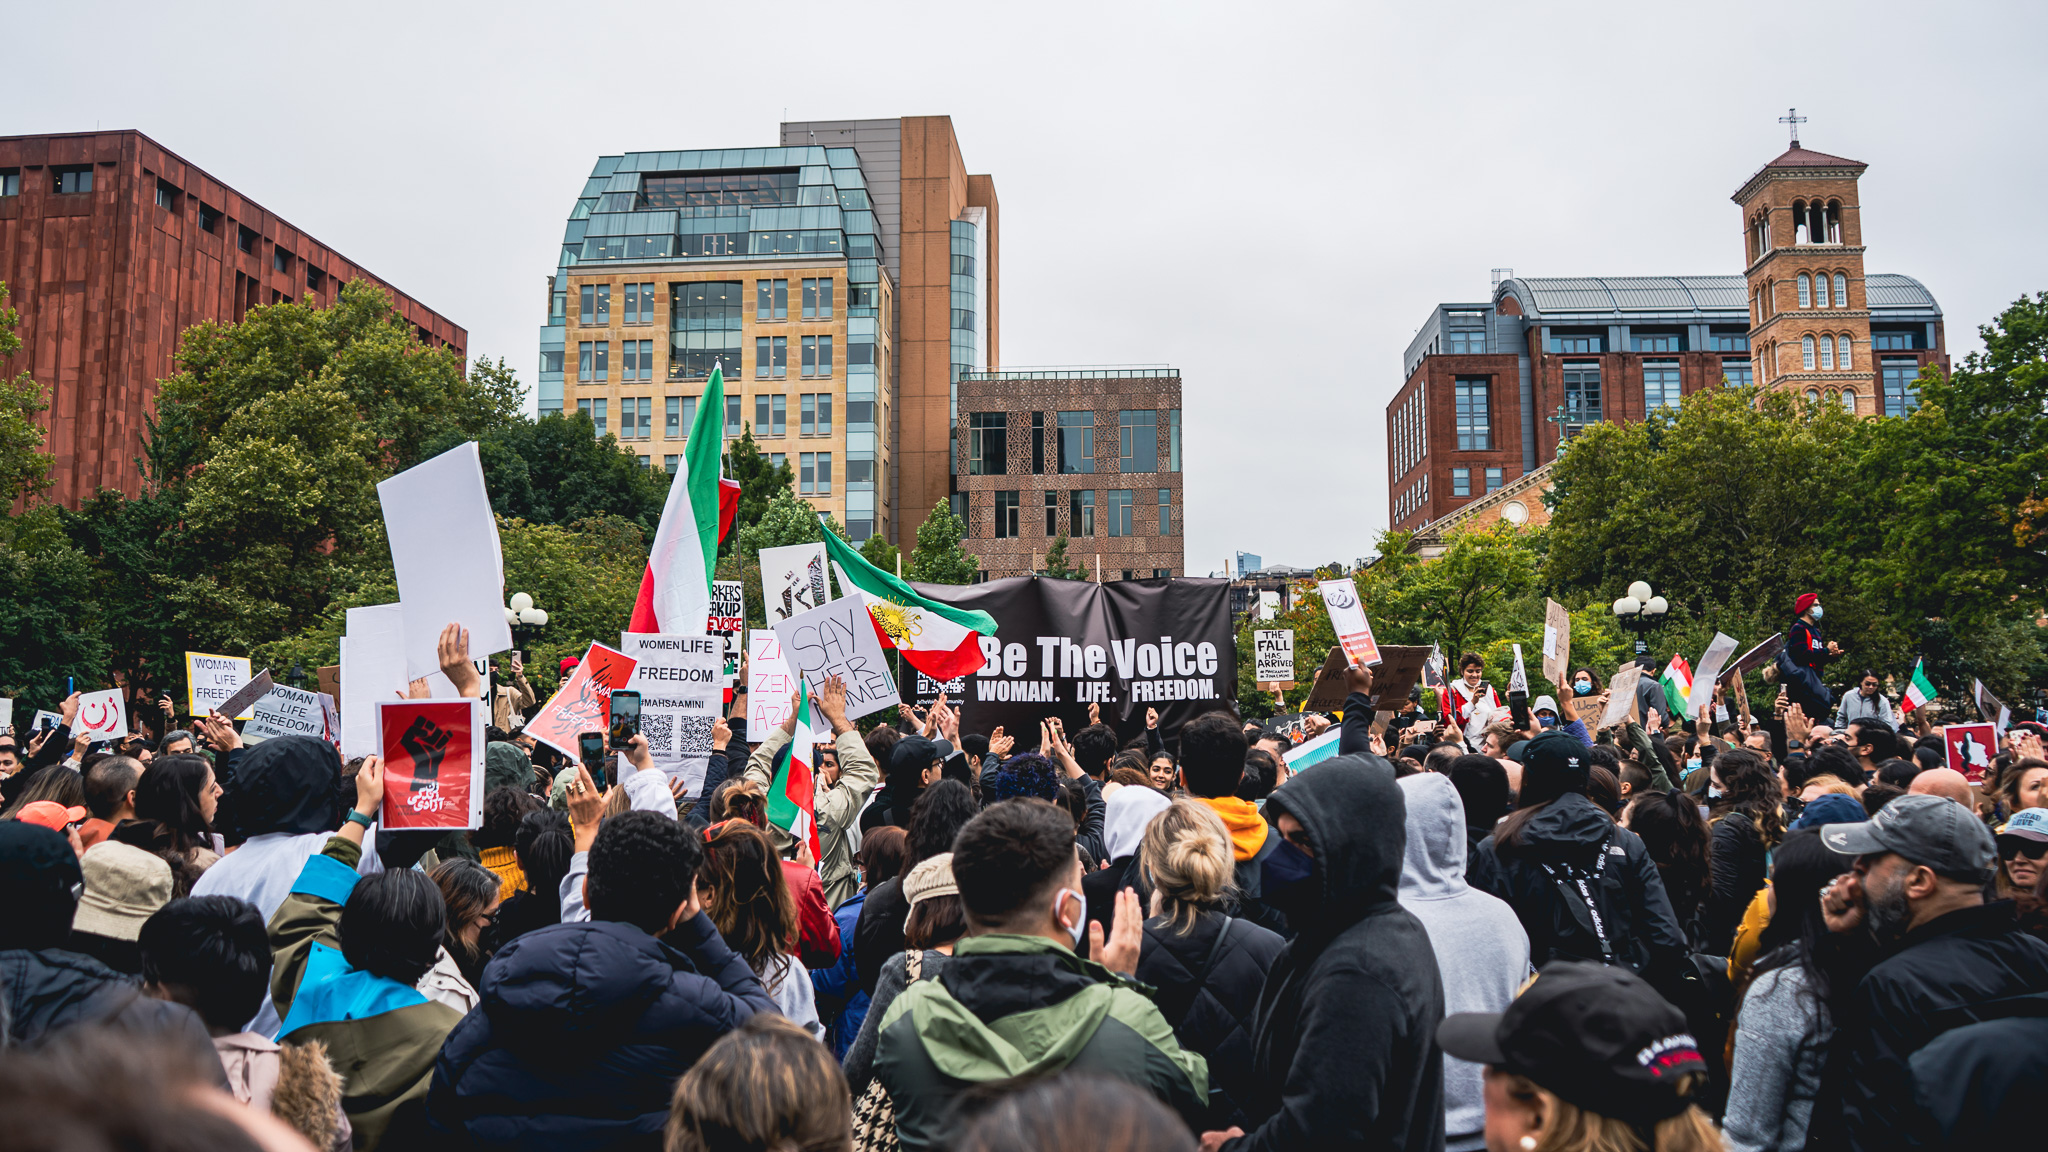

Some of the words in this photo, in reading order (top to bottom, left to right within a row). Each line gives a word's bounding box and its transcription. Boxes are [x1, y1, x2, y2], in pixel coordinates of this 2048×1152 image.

[712, 584, 741, 602] RKERS
[792, 609, 855, 672] SAY
[1262, 631, 1284, 639] THE
[639, 640, 679, 650] WOMEN
[681, 640, 713, 653] LIFE
[1258, 640, 1290, 651] FALL
[195, 658, 236, 671] WOMAN
[977, 636, 1027, 677] Be
[1037, 636, 1106, 678] The
[1111, 636, 1218, 679] Voice
[1258, 659, 1294, 668] ARRIVED
[214, 674, 237, 686] LIFE
[639, 667, 713, 682] FREEDOM
[196, 687, 238, 699] FREED
[581, 676, 612, 698] WOMA
[977, 680, 1060, 702] WOMAN.
[1077, 681, 1117, 703] LIFE.
[1132, 679, 1220, 702] FREEDOM.
[280, 703, 308, 718] LIFE
[577, 697, 602, 715] LIFE
[641, 699, 704, 708] #MAHSAAMINI
[82, 697, 119, 733] زن
[253, 710, 315, 734] FREEDOM
[1590, 908, 1605, 938] adidas
